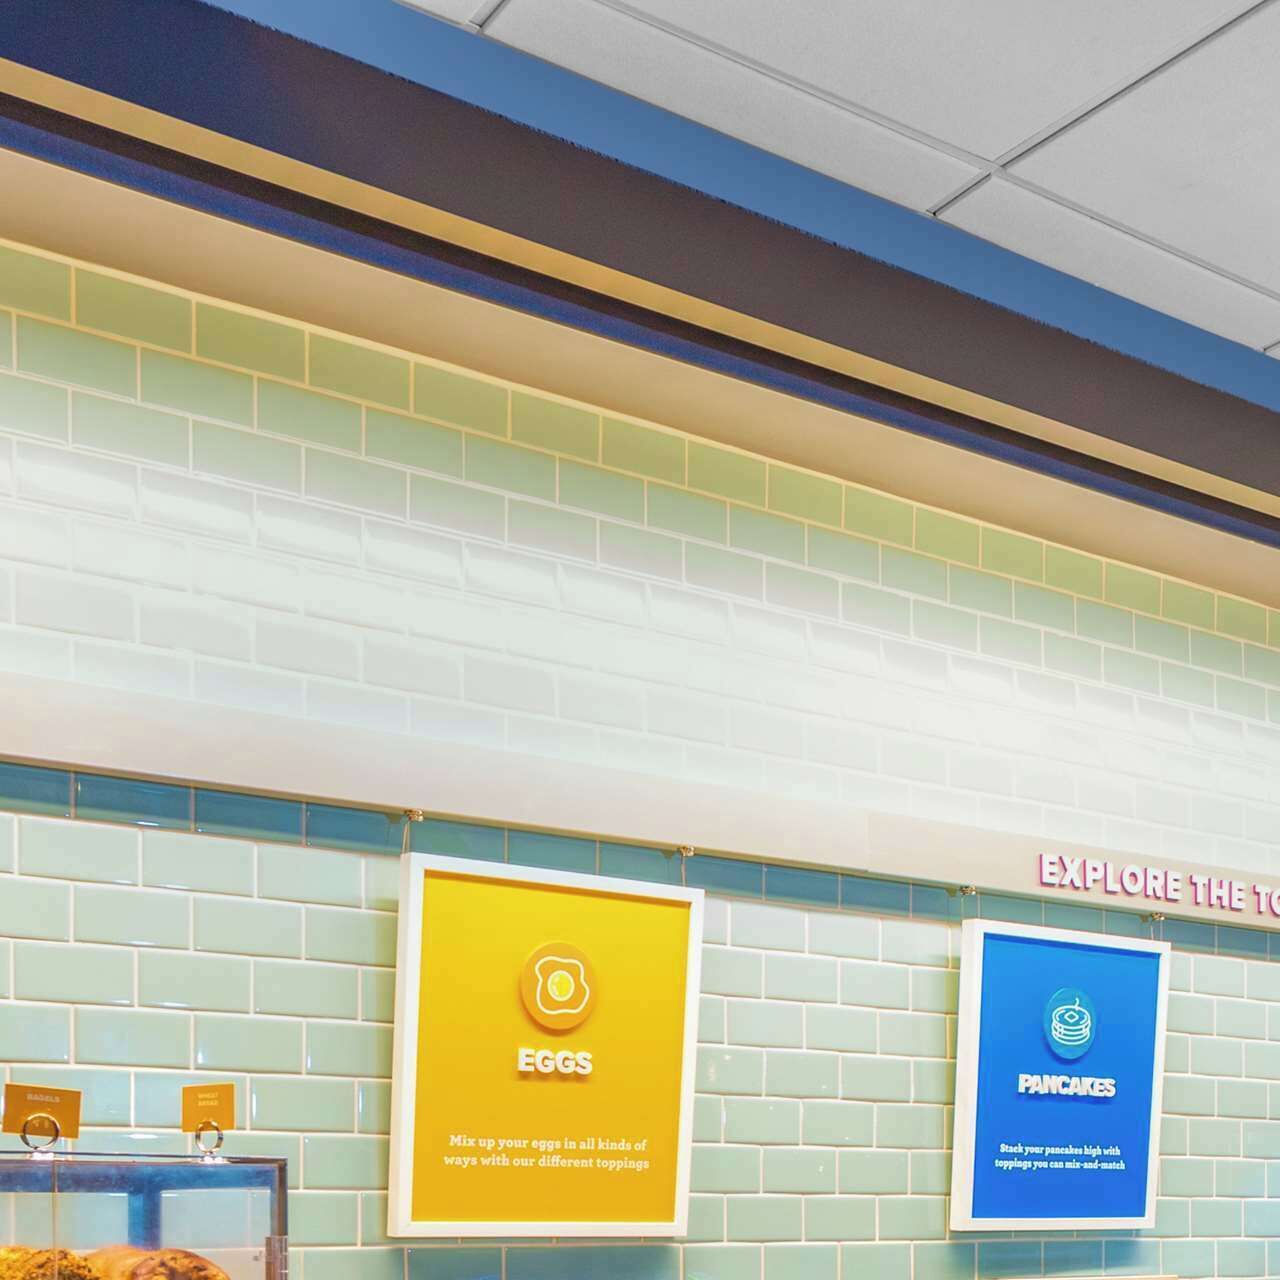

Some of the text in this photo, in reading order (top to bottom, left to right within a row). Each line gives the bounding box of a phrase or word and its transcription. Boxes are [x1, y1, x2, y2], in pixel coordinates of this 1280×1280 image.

[1040, 853, 1183, 902] EXPLORE
[1190, 873, 1247, 911] THE
[517, 1048, 593, 1076] EGGS
[1018, 1073, 1116, 1098] PANCAKES
[449, 1134, 648, 1152] Mix up your eggs in all kinds of
[1000, 1142, 1121, 1157] Stack your pancakes high with
[443, 1153, 650, 1172] ways with our different toppings
[994, 1157, 1126, 1171] toppings you can mix-and-match
